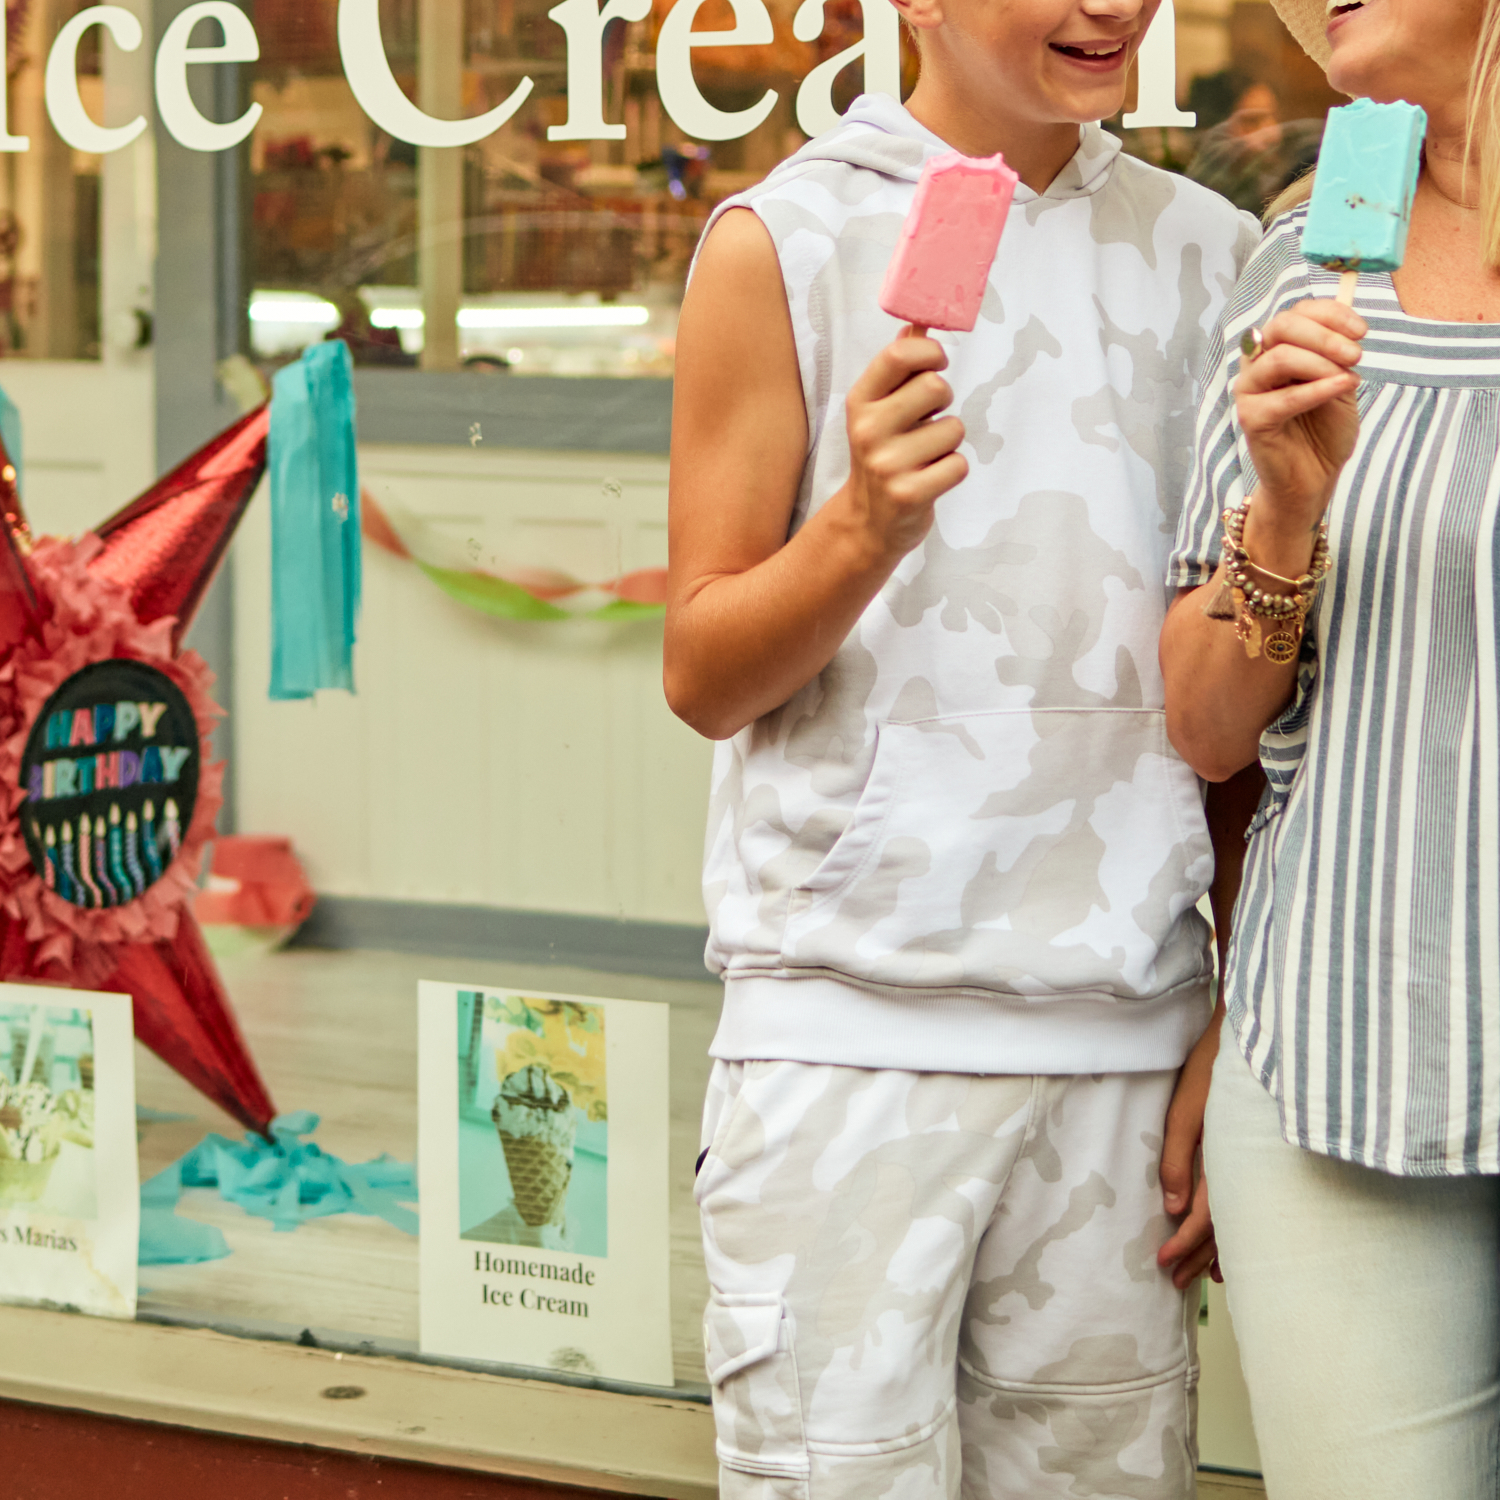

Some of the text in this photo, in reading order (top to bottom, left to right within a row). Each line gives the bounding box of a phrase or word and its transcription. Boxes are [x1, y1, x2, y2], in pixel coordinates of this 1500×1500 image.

[46, 701, 168, 749] HAPPY
[29, 746, 191, 803] BIRTHDAY
[13, 1226, 78, 1252] Marias
[474, 1251, 595, 1286] Homemade
[482, 1284, 589, 1318] Ice Cream
